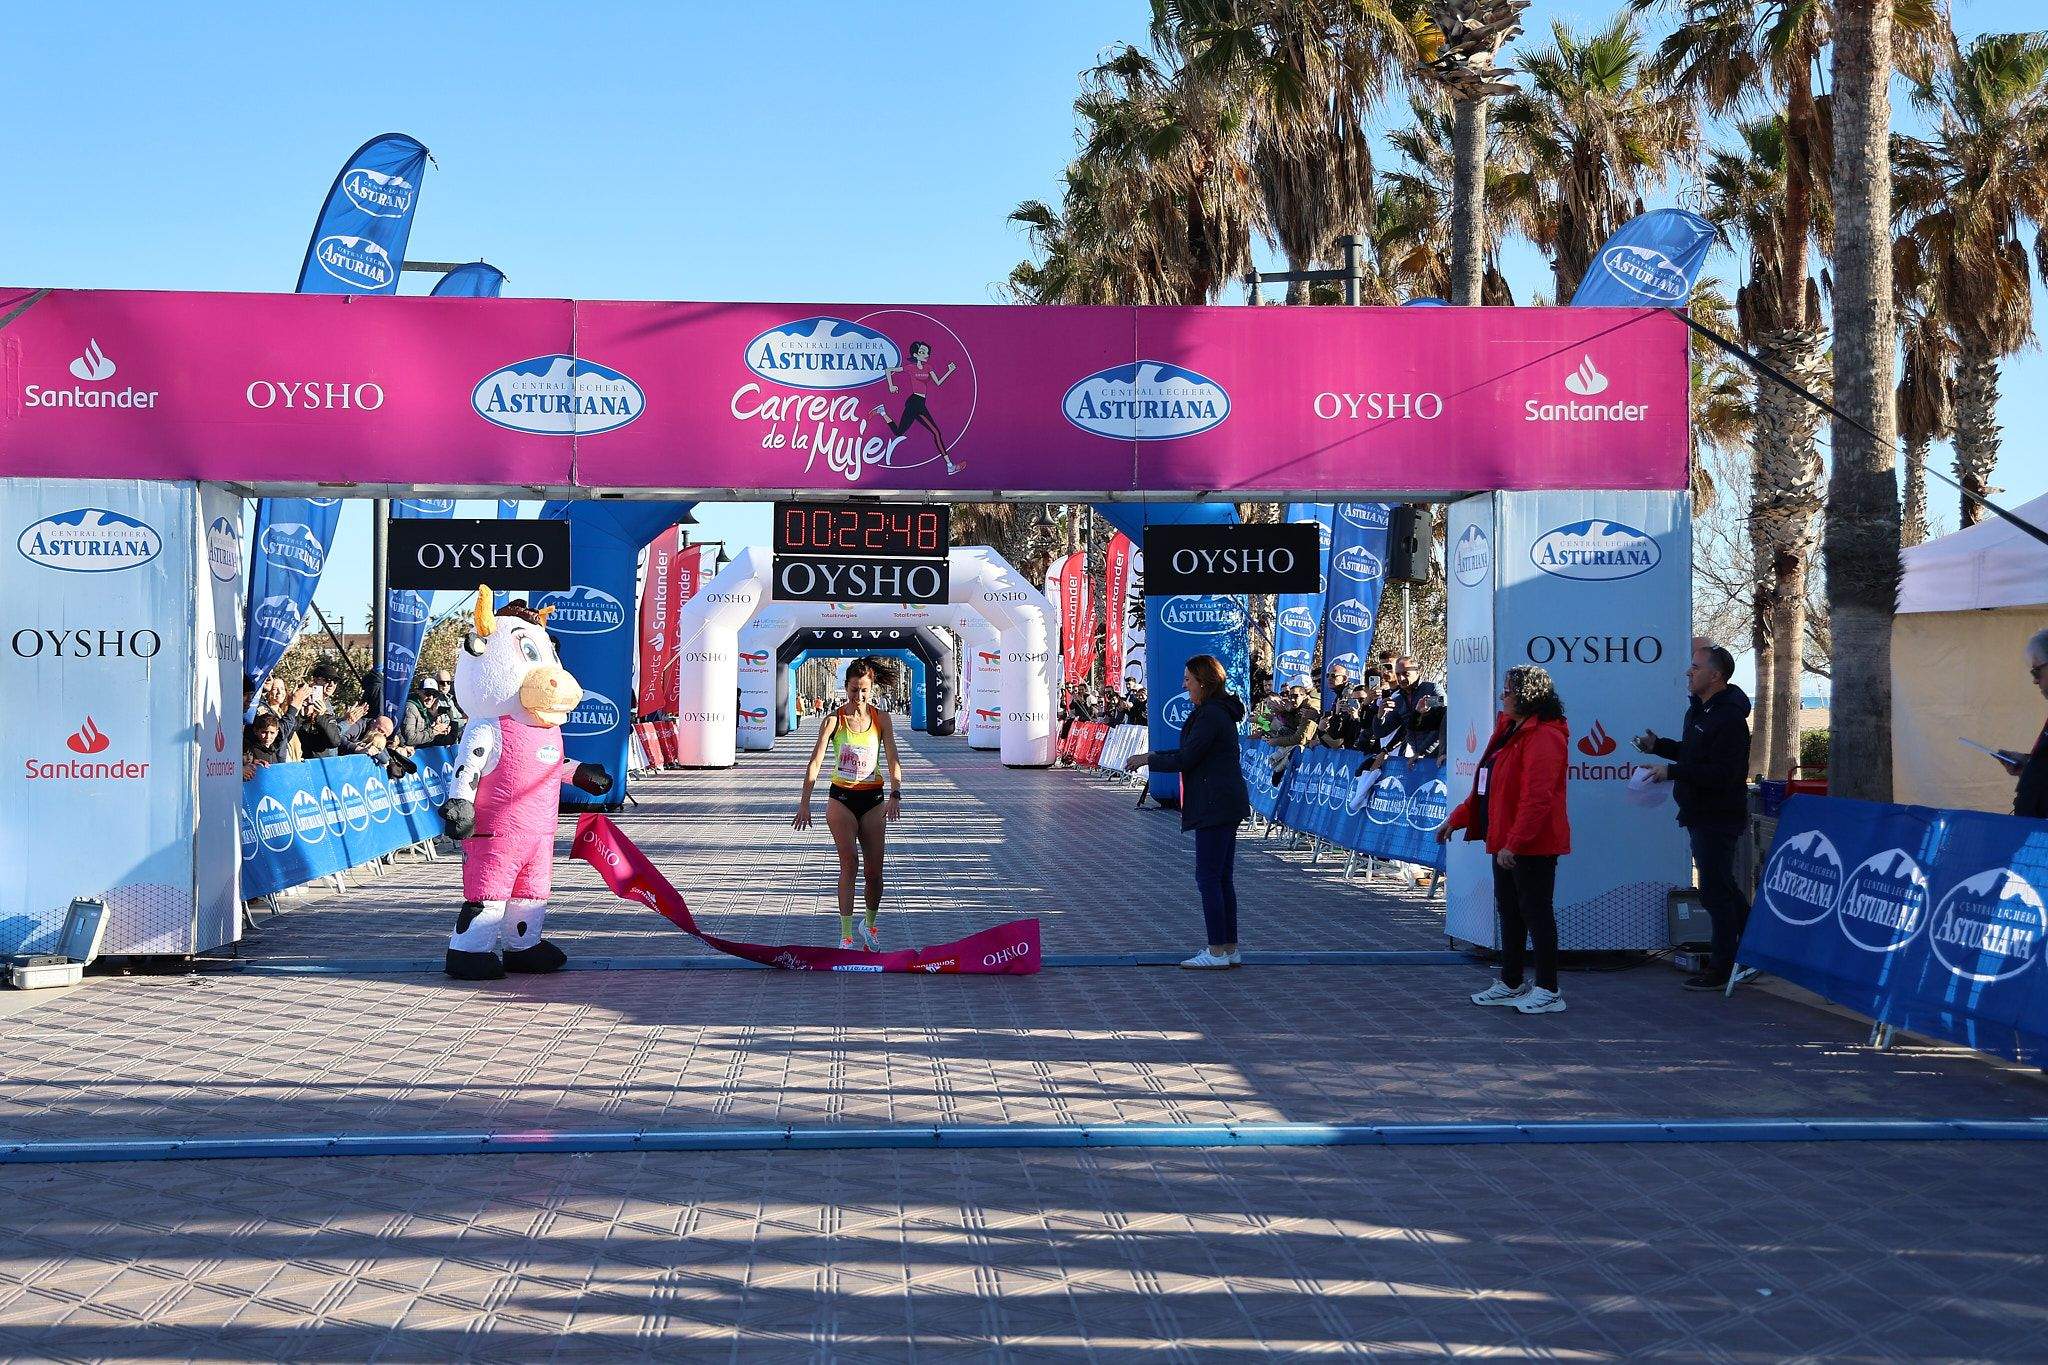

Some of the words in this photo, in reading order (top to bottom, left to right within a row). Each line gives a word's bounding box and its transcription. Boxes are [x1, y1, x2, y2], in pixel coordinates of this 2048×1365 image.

[1607, 252, 1680, 296] ASTURIANA
[757, 343, 888, 371] ASTURIANA
[781, 341, 830, 349] CENTRAL
[835, 342, 884, 350] LECHERA
[24, 384, 159, 409] Santander
[246, 380, 385, 411] OYSHO
[485, 383, 633, 416] ASTURIANA
[512, 382, 566, 390] CENTRAL
[1101, 388, 1153, 397] CENTRAL
[1159, 388, 1213, 396] LECHERA
[730, 383, 860, 423] Carrera
[1075, 390, 1218, 420] ASTURIANA
[1313, 392, 1443, 420] OYSHO
[1524, 399, 1649, 422] Santander
[761, 423, 786, 450] de
[791, 423, 808, 450] la
[804, 418, 907, 481] Mujer
[28, 531, 151, 557] ASTURIANA
[786, 510, 938, 549] 00:22:48
[417, 543, 544, 569] OYSHO
[1172, 547, 1295, 574] OYSHO
[1540, 542, 1652, 566] ASTURIANA
[652, 549, 668, 630] Santander
[781, 562, 941, 599] OYSHO
[1111, 551, 1125, 632] Santander
[706, 593, 751, 604] OYSHO
[983, 591, 1028, 602] OYSHO
[11, 629, 161, 658] OYSHO
[206, 630, 238, 662] OYSHO
[812, 630, 900, 639] VOLVO
[1008, 652, 1049, 662] OYSHO
[1453, 635, 1489, 665] OYSHO
[1527, 635, 1663, 664] OYSHO
[1112, 656, 1121, 693] ports
[566, 711, 614, 725] URIANA
[25, 759, 150, 779] Santander
[1568, 762, 1637, 780] ntand
[583, 830, 621, 866] OYSHO
[1767, 855, 1834, 909] ASTURIANA
[1841, 878, 1920, 933] ASTURIANA
[1935, 900, 2034, 960] ASTURIANA
